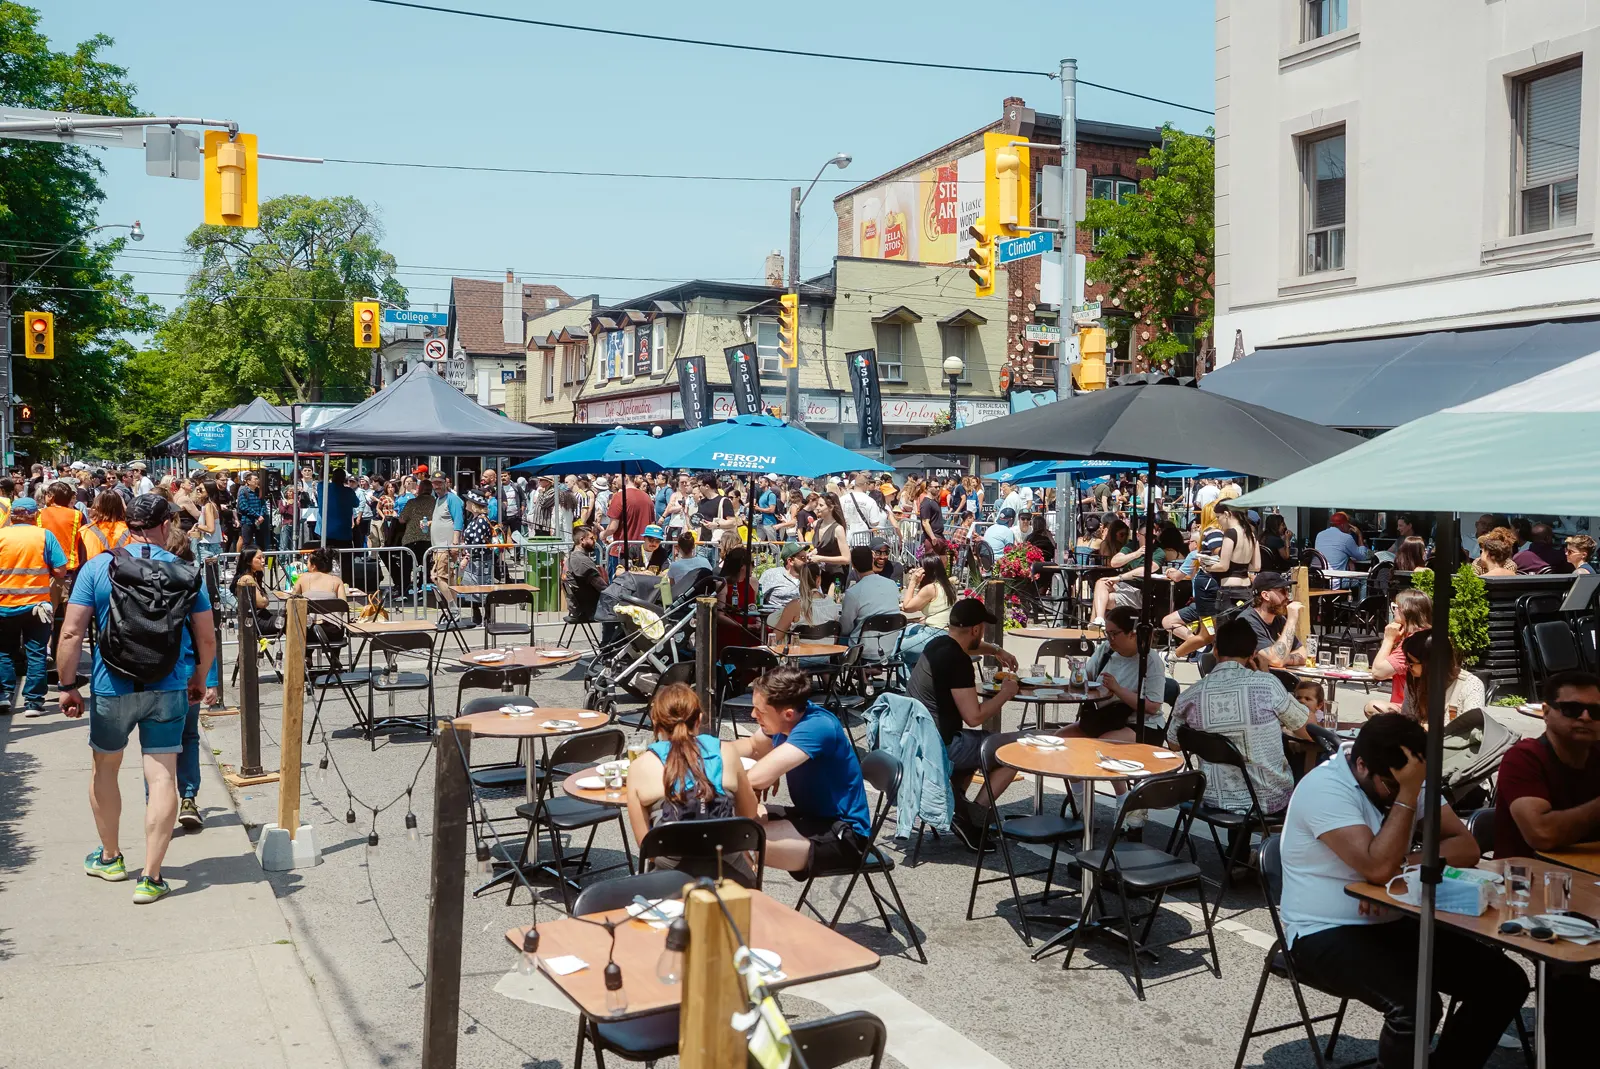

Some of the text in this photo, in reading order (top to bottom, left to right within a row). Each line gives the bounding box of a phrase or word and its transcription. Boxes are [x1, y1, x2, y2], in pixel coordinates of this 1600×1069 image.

[939, 182, 957, 199] STE
[1008, 235, 1044, 257] Clinton St
[395, 311, 429, 324] College
[449, 361, 465, 370] TWO
[448, 371, 465, 379] WAY
[714, 397, 737, 416] Caf
[860, 367, 873, 445] SPIDUCCI
[237, 439, 293, 451] DI STRA
[711, 452, 777, 464] PERONI
